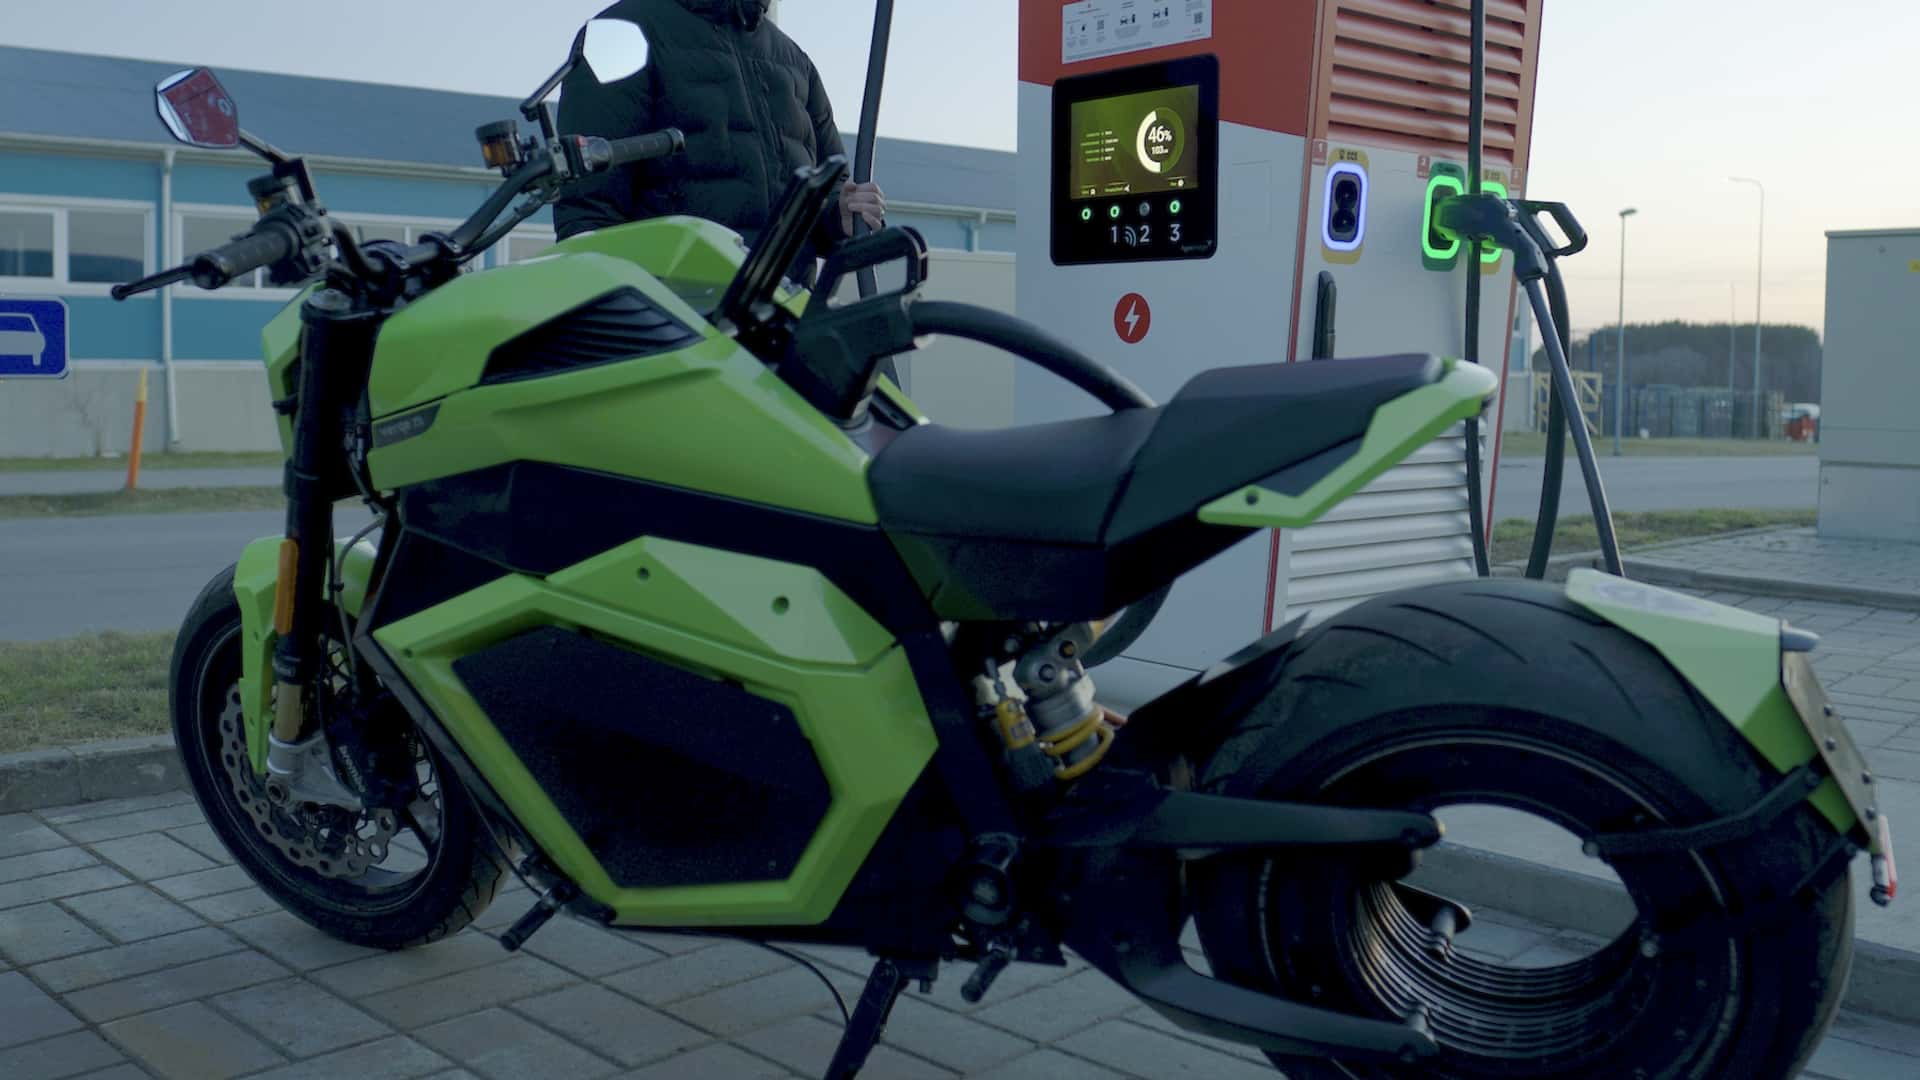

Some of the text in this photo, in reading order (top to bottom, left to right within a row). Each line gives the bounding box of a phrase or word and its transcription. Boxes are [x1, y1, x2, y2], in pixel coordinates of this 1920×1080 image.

[1148, 125, 1173, 143] 46%
[1111, 223, 1180, 243] 1 2 3
